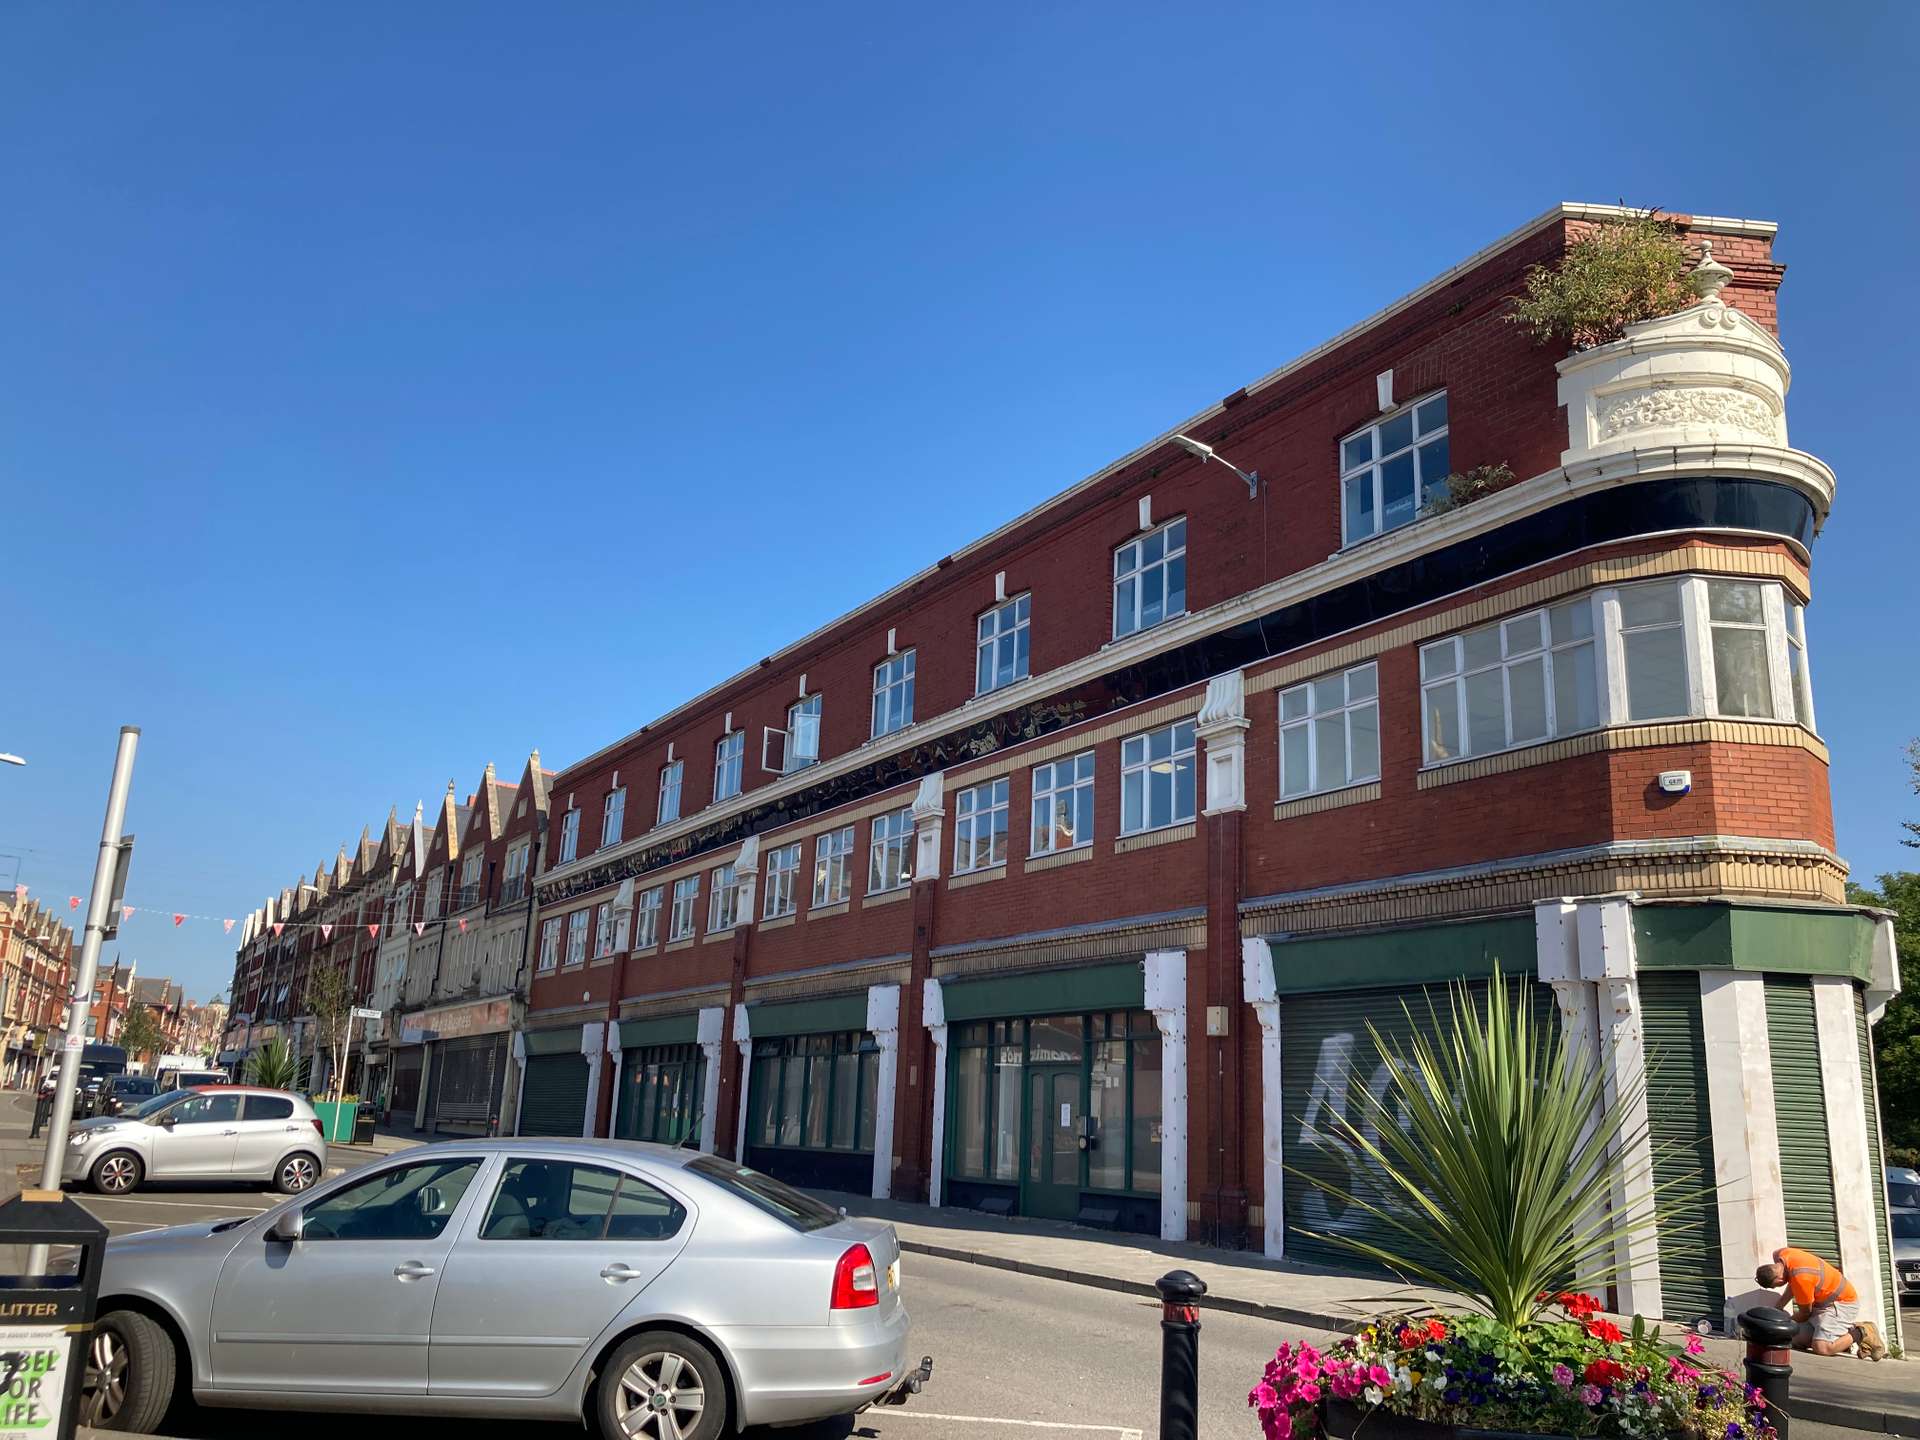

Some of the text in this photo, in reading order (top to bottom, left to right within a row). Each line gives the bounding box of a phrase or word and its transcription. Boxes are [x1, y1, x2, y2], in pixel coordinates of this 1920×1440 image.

[0, 1303, 58, 1316] LITTER
[3, 1350, 56, 1372] BEL
[8, 1376, 41, 1399] OR
[0, 1402, 39, 1425] IFE
